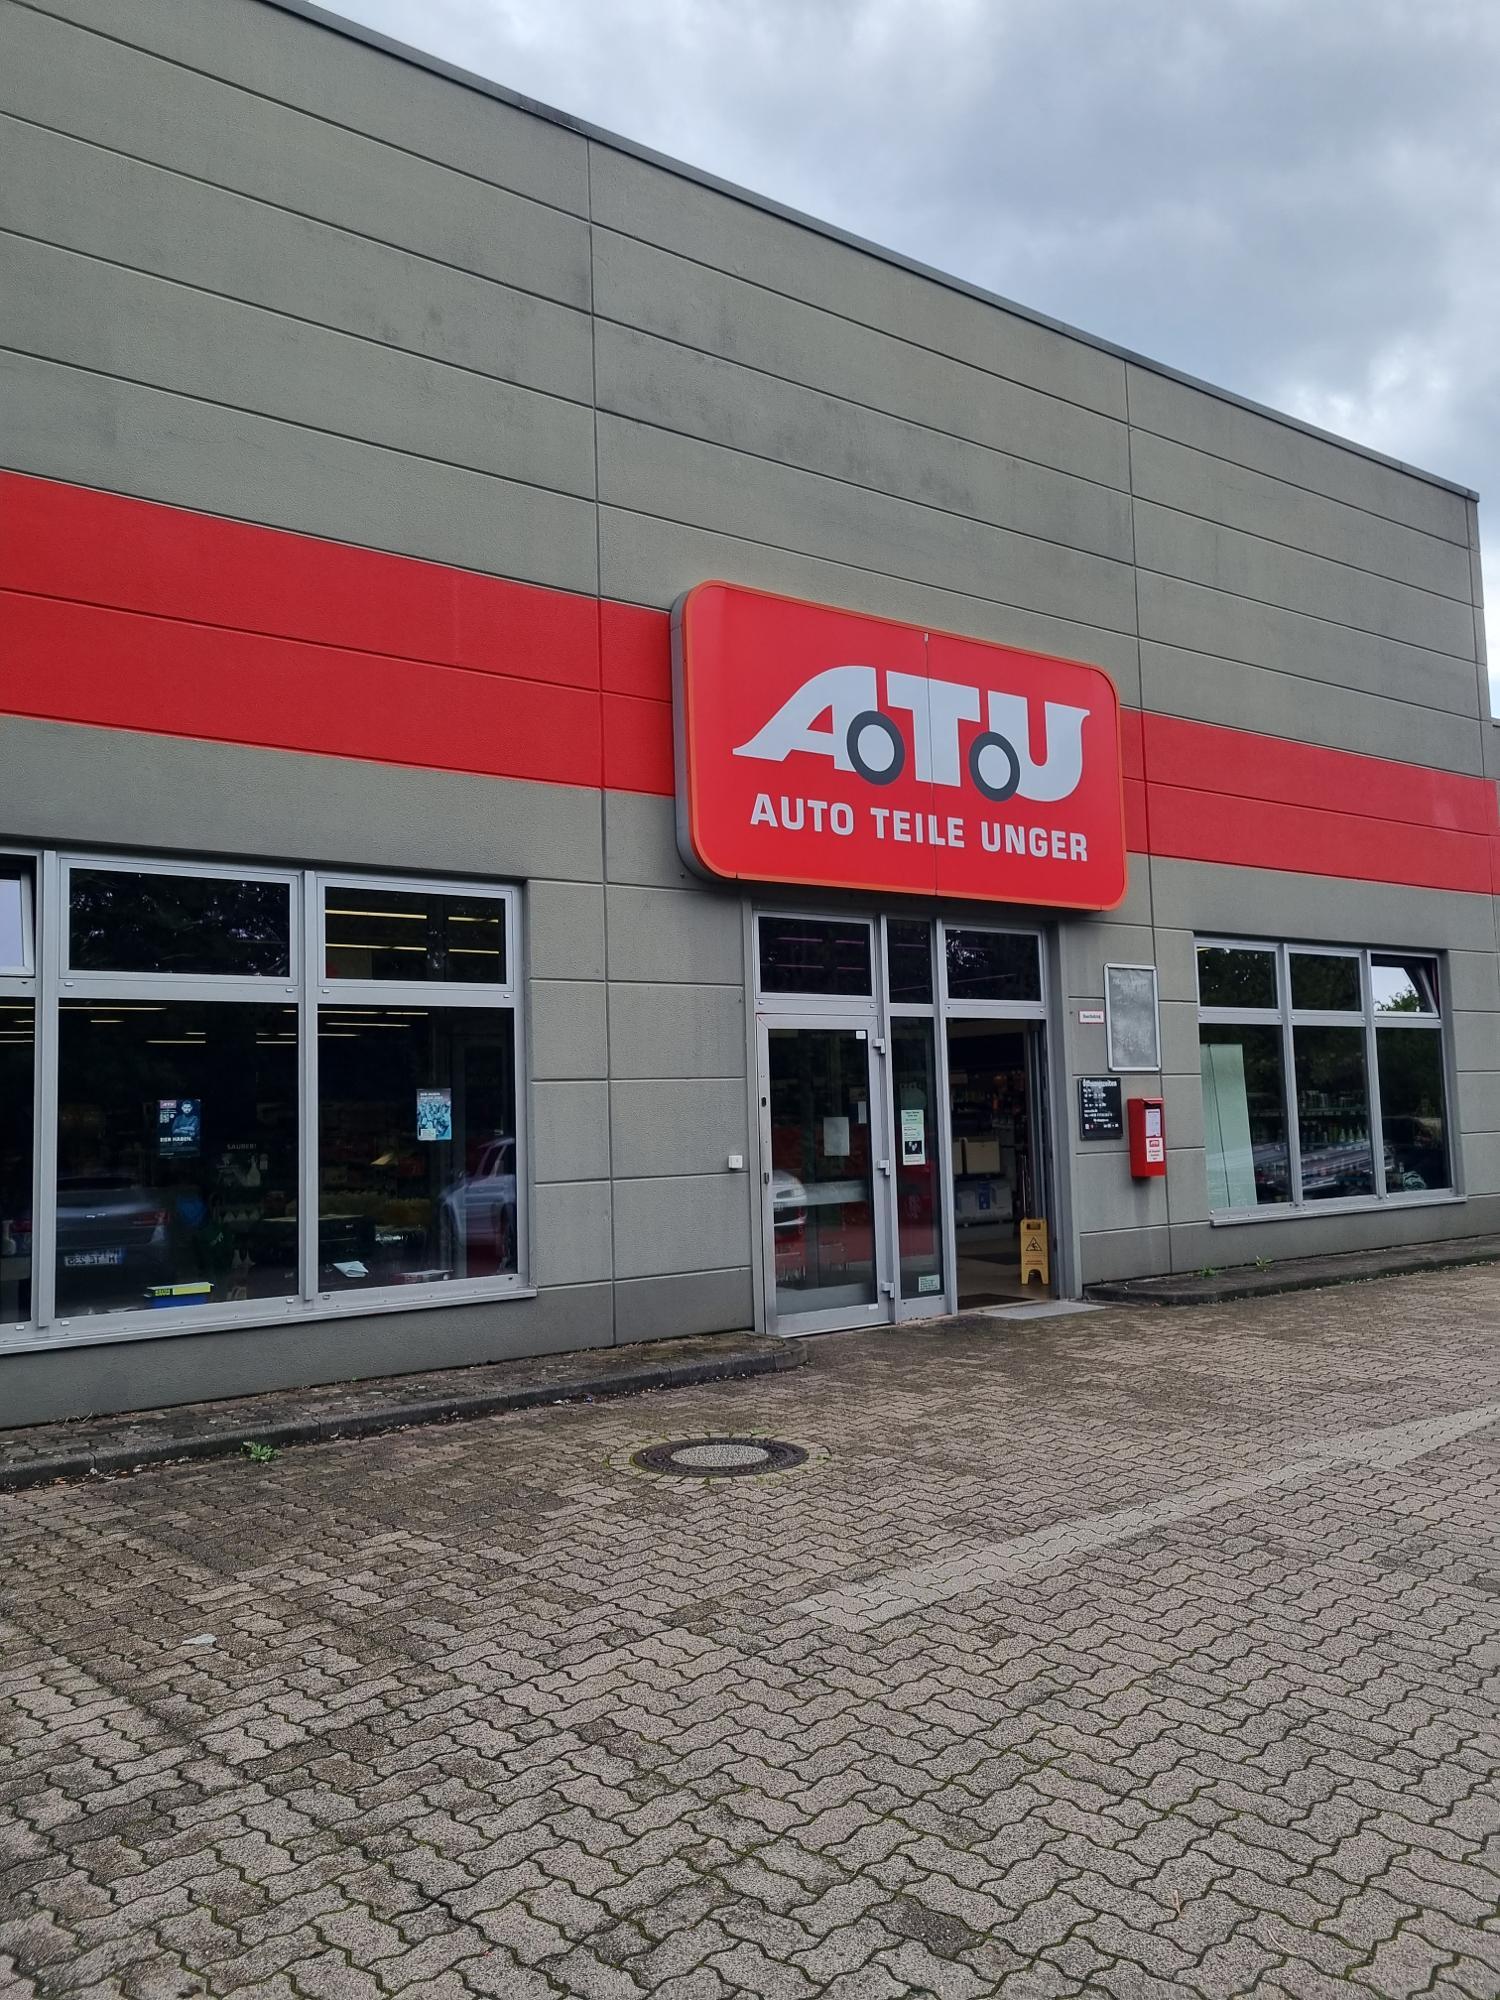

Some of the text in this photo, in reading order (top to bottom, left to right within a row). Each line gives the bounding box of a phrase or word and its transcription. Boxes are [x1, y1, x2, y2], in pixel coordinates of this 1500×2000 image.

[750, 793, 1088, 862] AUTO TEILE UNGER
